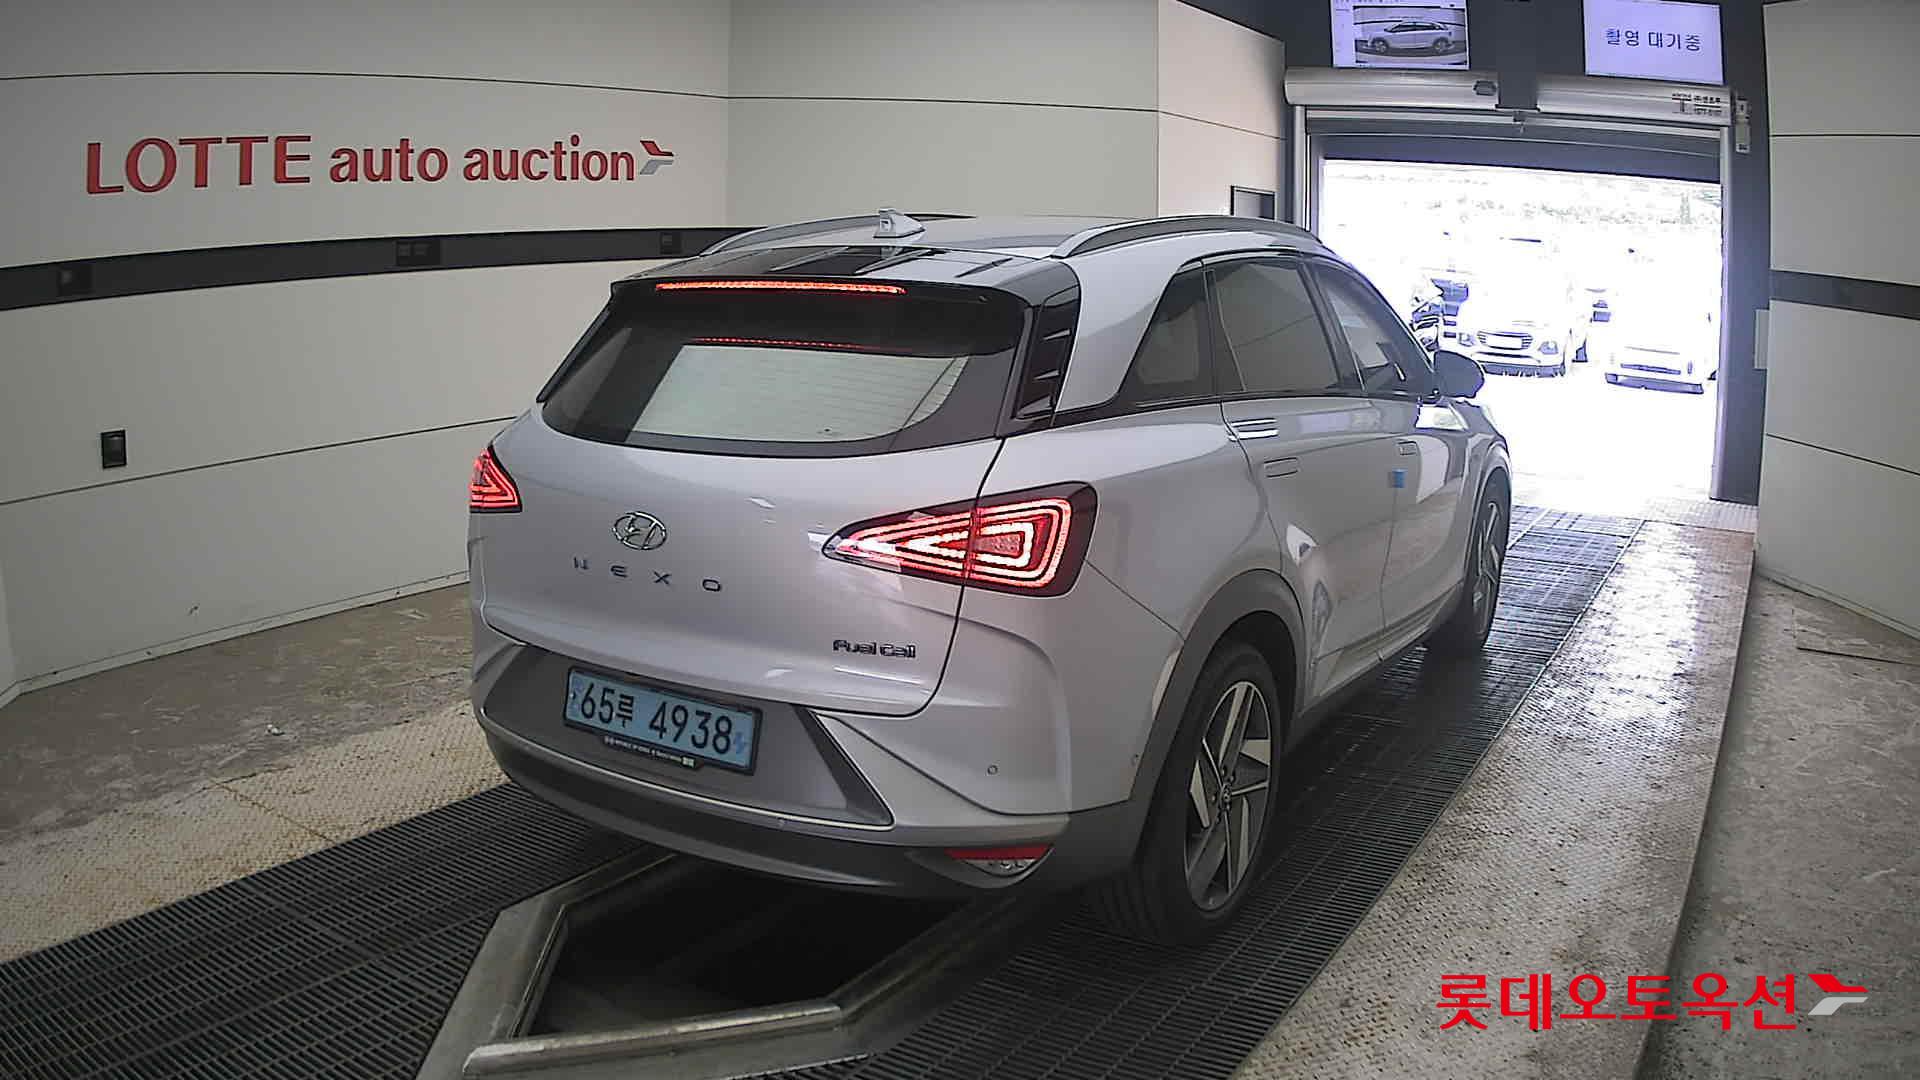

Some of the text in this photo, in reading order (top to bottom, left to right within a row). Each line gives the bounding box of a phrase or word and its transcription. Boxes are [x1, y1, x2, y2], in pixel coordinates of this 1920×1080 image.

[1647, 31, 1701, 52] 대기중
[86, 134, 634, 194] LOTTE auto auction
[573, 556, 723, 592] NEXO
[833, 639, 916, 658] Fuel Cell
[581, 683, 634, 728] 65루
[649, 701, 732, 754] 4938
